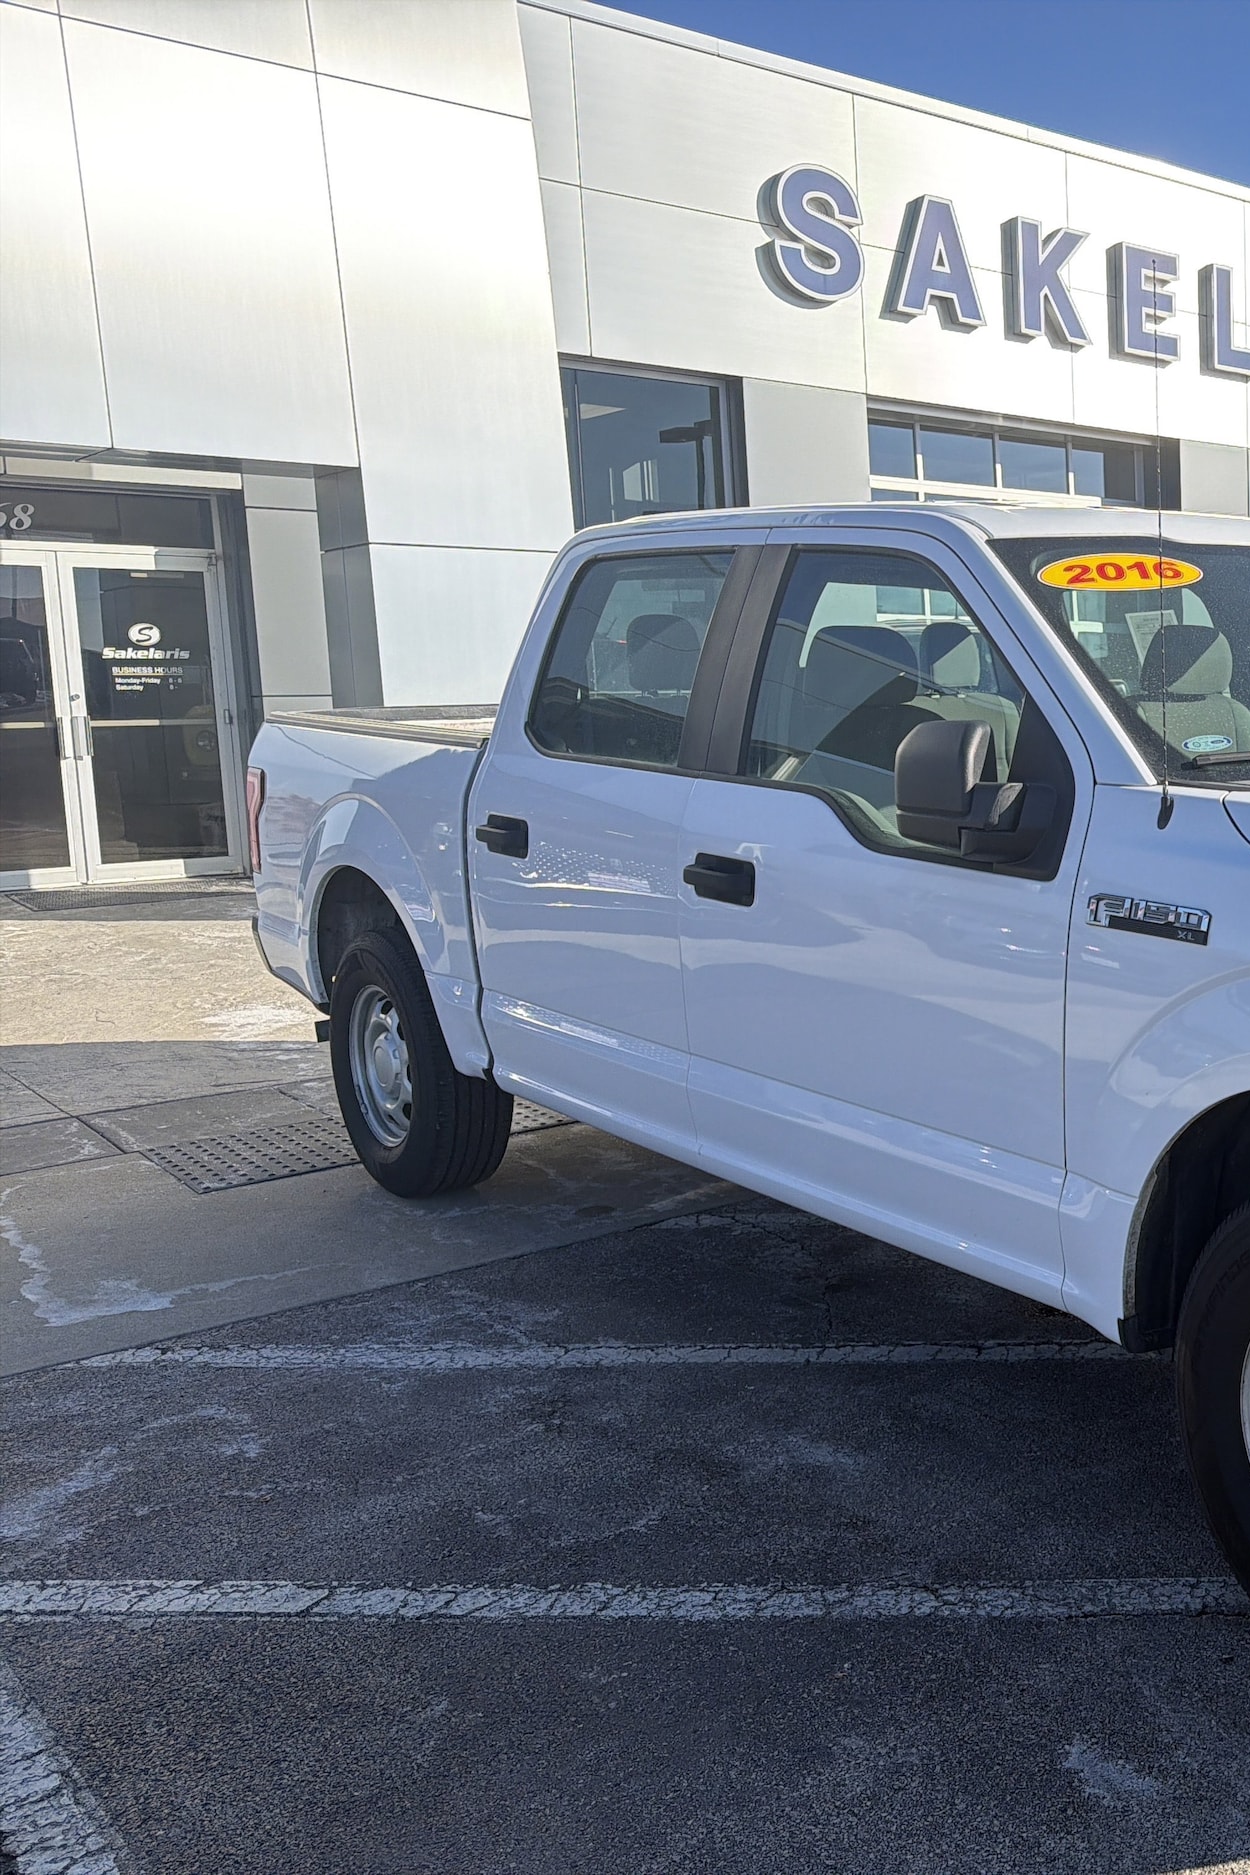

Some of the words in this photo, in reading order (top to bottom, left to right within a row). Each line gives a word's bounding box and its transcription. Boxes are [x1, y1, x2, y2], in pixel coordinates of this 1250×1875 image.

[1063, 561, 1184, 585] 2016
[135, 626, 154, 643] S
[102, 647, 190, 660] Sakelaris
[112, 666, 153, 674] BUSINESS
[154, 666, 183, 674] HOURS
[114, 677, 161, 685] Monday-Friday
[115, 684, 144, 692] Saturday
[1177, 930, 1195, 941] XL
